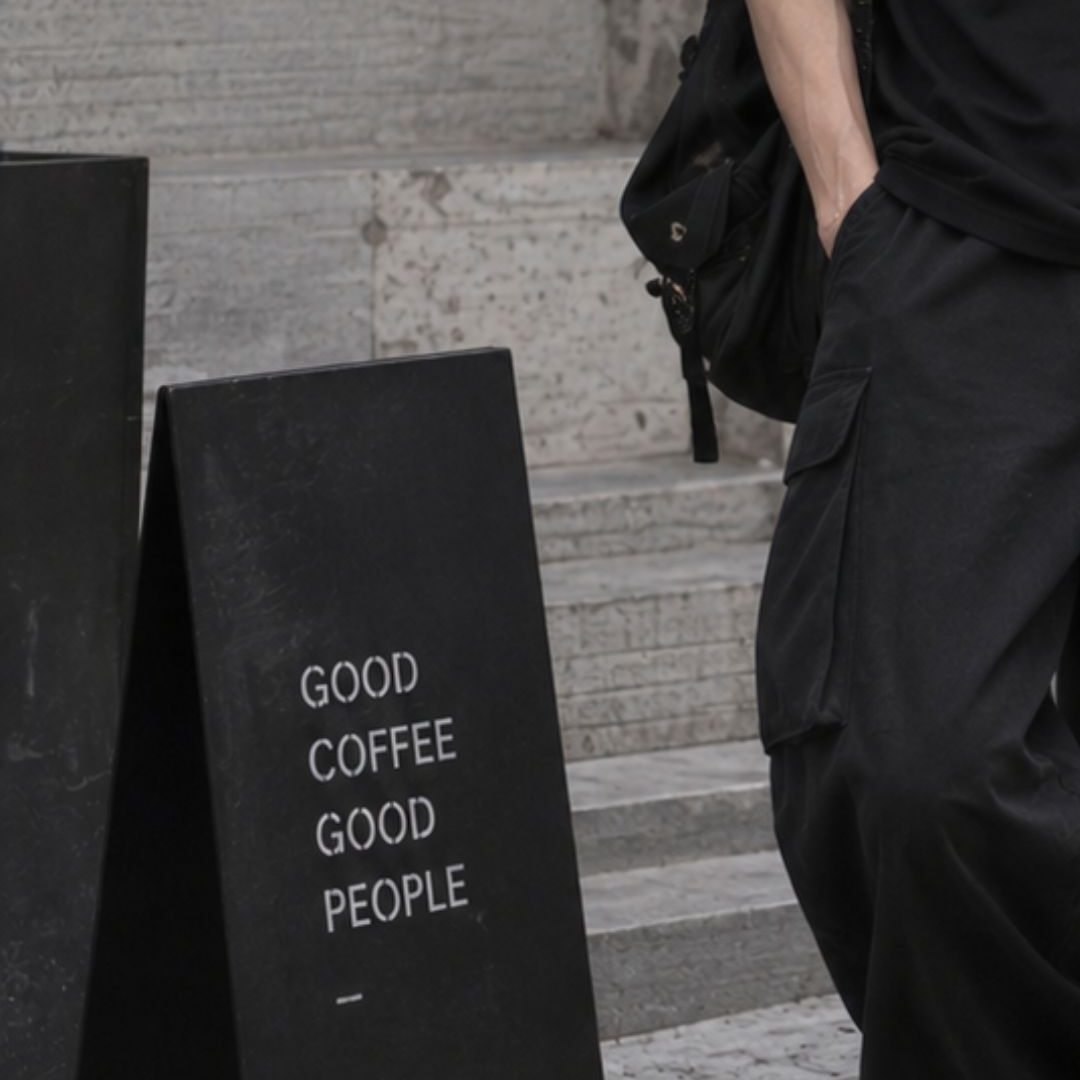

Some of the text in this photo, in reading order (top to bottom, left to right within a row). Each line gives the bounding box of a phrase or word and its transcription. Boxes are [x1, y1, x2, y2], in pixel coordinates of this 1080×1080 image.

[300, 651, 419, 708] GOOD
[308, 717, 457, 782] COFFEE
[316, 796, 435, 857] GOOD
[323, 863, 469, 933] PEOPLE
